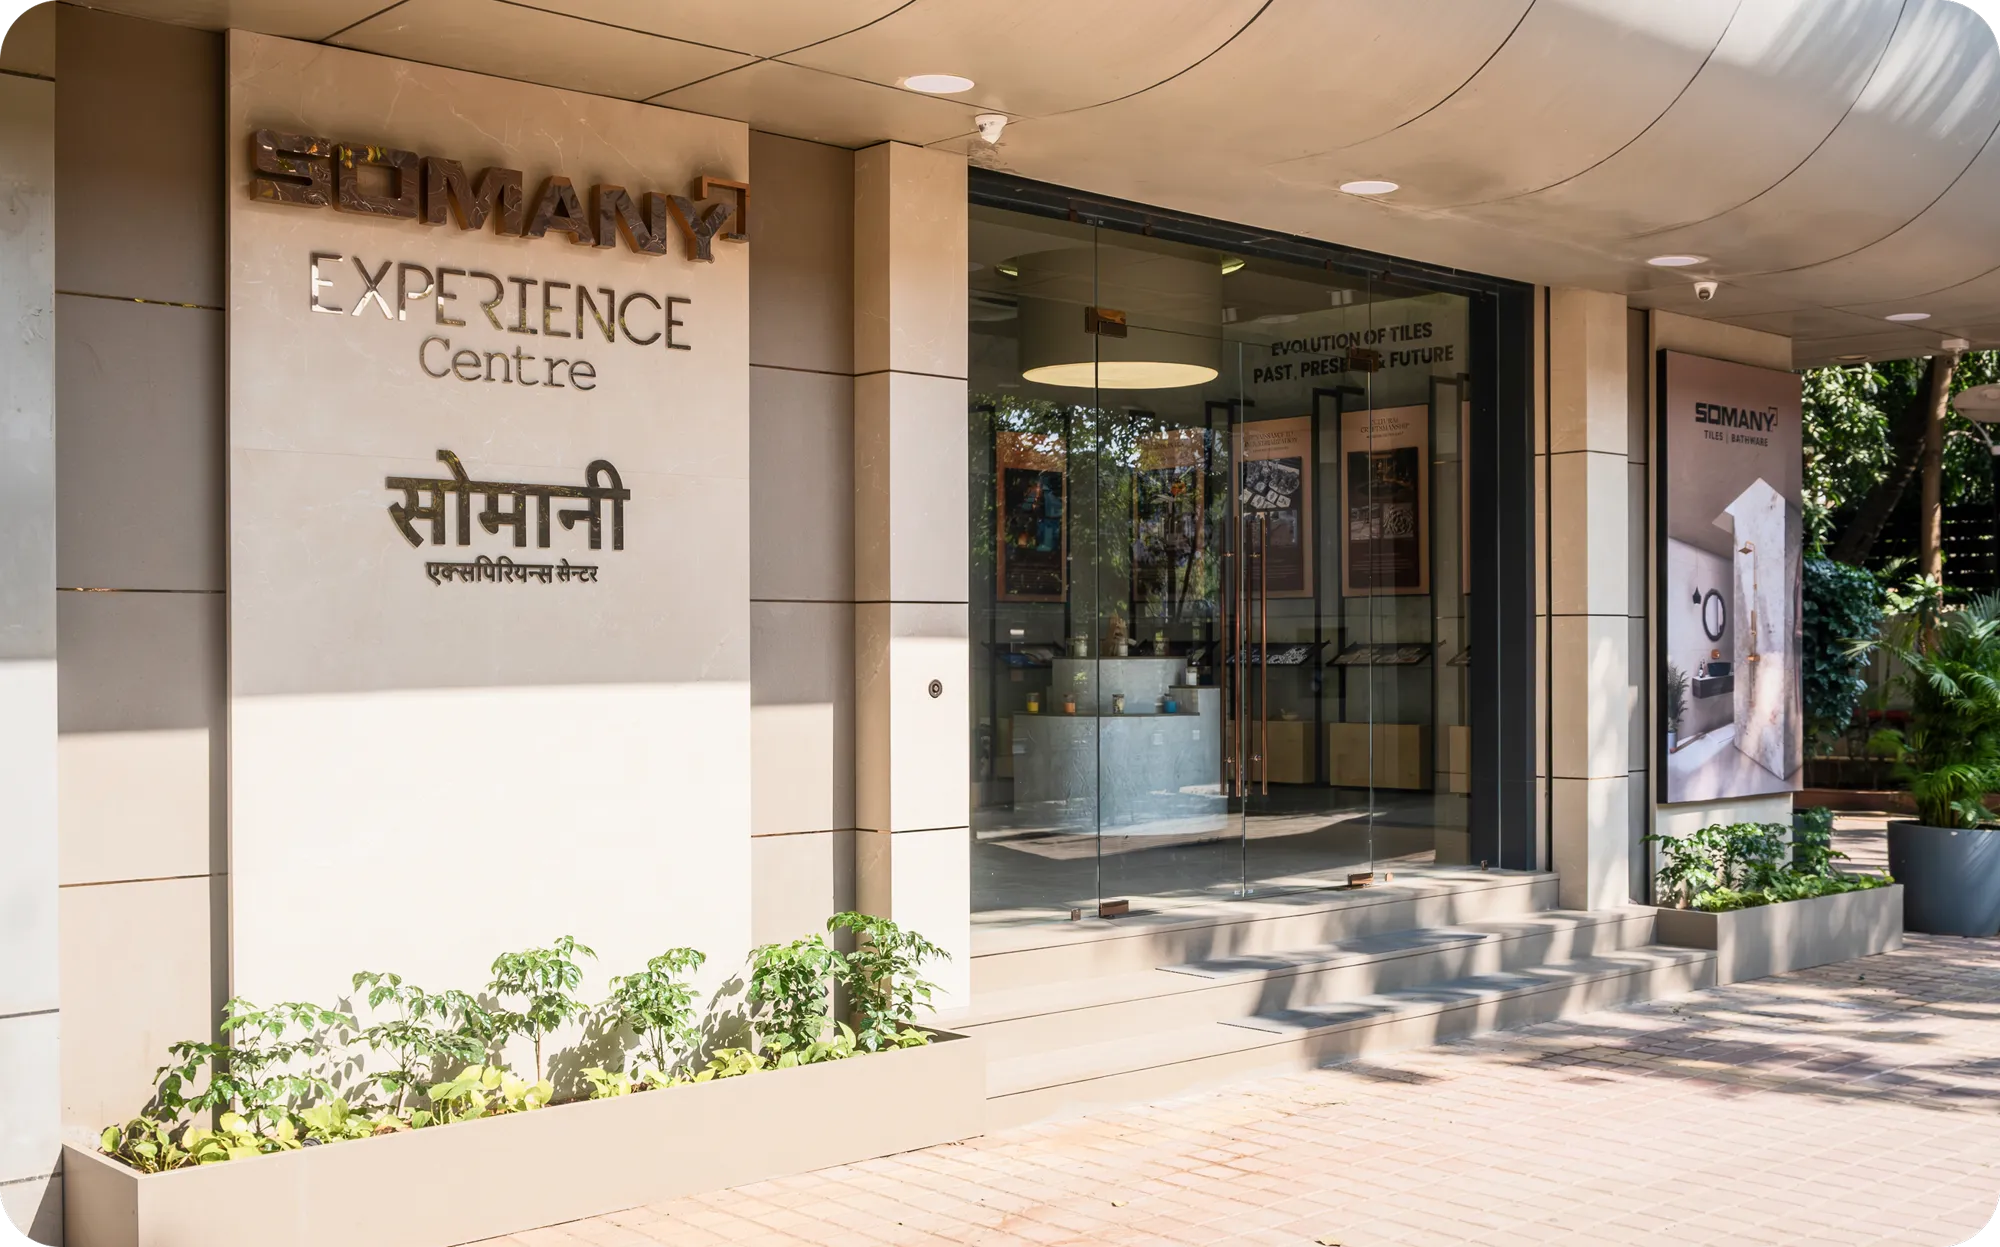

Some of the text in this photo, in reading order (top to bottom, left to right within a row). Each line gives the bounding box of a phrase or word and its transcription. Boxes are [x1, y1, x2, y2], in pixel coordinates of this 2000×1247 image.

[250, 128, 738, 263] SOMANY
[310, 252, 692, 351] EXPERIENCE
[1271, 322, 1432, 357] EVOLUTION OF TILES
[419, 335, 597, 391] Centre
[1253, 364, 1298, 384] PAST,
[1301, 356, 1351, 378] PRESE
[1390, 345, 1454, 368] FUTURE
[1360, 423, 1410, 433] CRFTSMANSHIP
[1695, 402, 1775, 433] SOMANY
[1704, 430, 1768, 447] TILES BATHWARE
[386, 449, 631, 550] सोमानी
[425, 554, 599, 586] एक्सपिरियन्स सेन्टर
